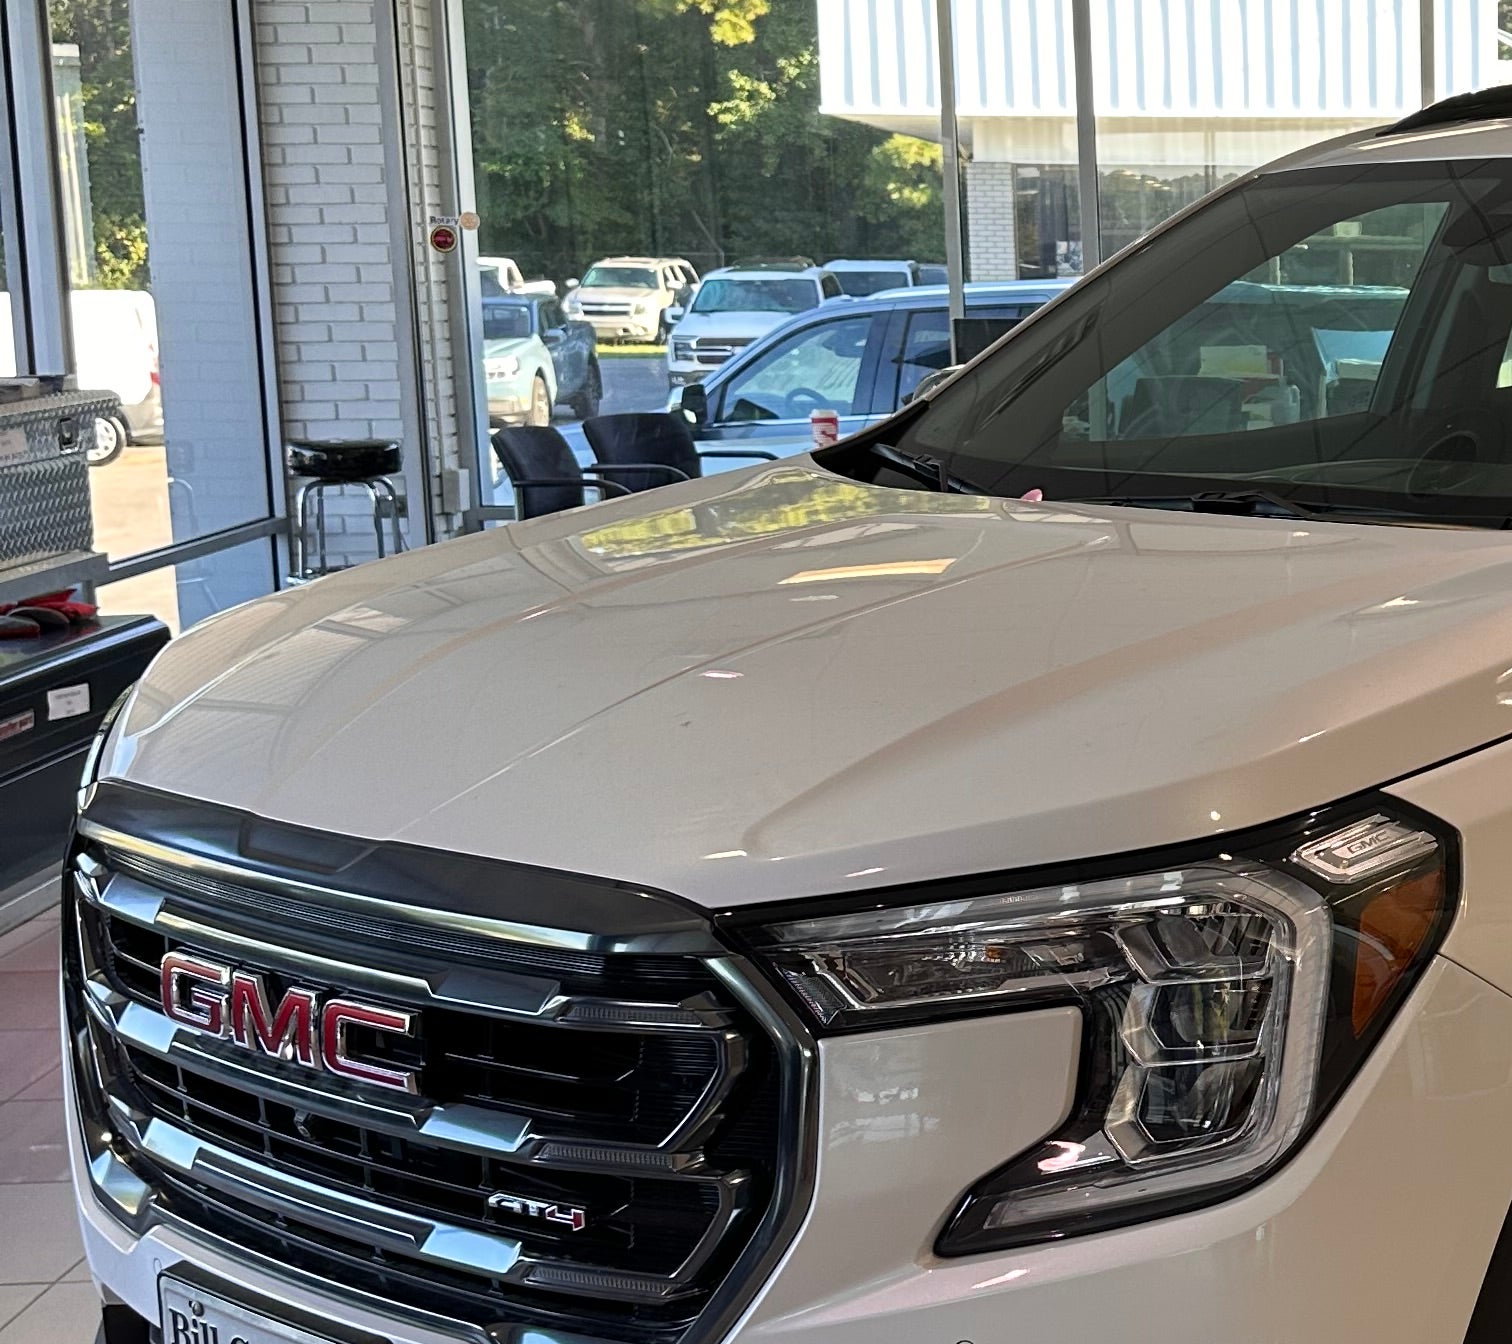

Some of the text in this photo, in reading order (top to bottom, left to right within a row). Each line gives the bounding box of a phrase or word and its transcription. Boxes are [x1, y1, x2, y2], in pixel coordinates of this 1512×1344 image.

[429, 215, 459, 226] Rotary
[1347, 830, 1388, 855] GMC
[160, 950, 420, 1096] GMC
[488, 1192, 586, 1232] AT4
